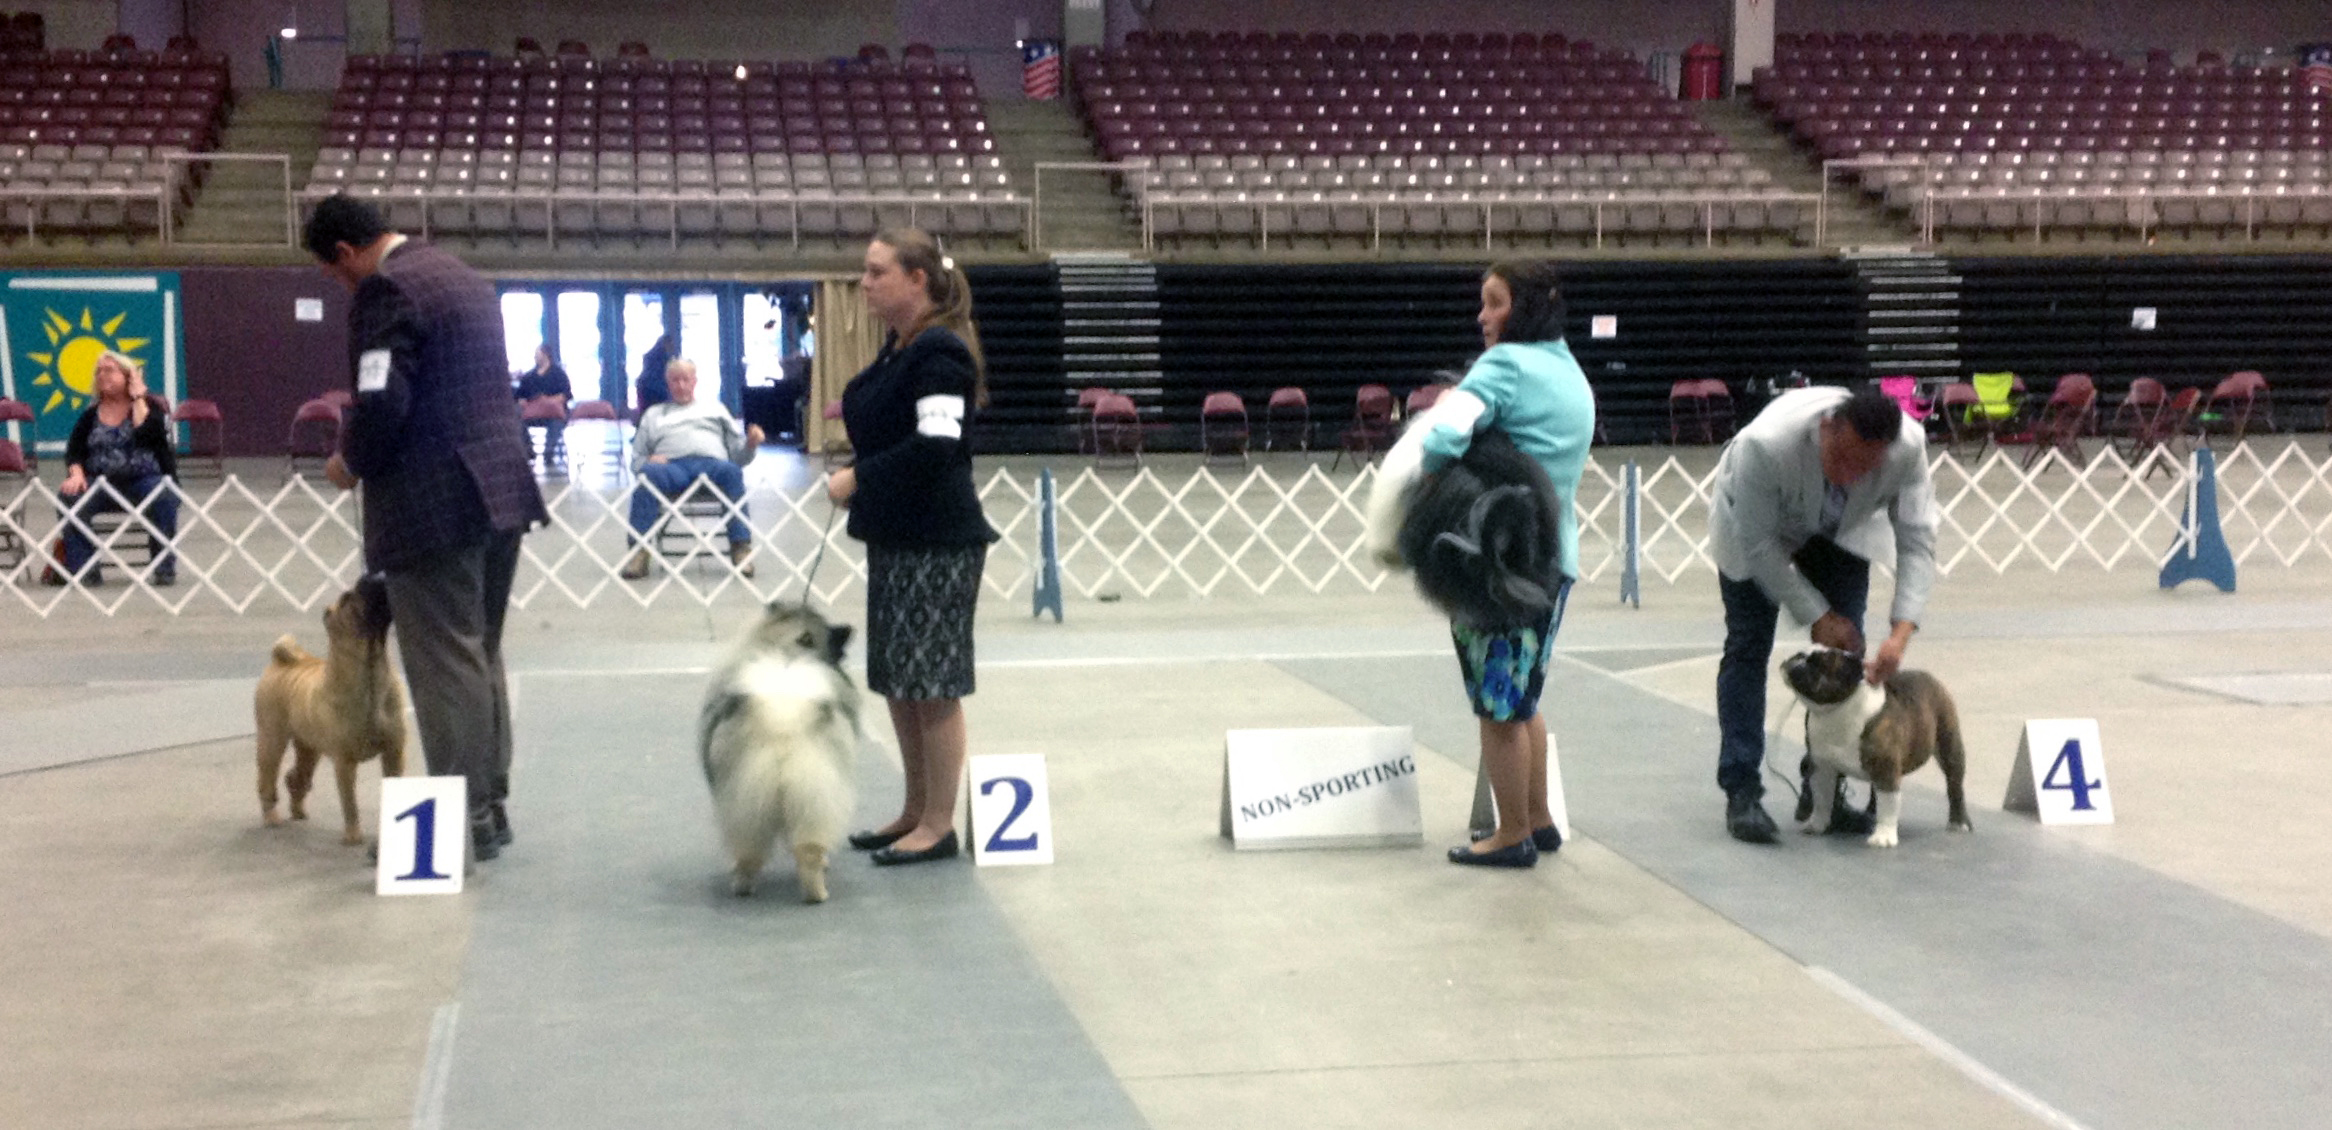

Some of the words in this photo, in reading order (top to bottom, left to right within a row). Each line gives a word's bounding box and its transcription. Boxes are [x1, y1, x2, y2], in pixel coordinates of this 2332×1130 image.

[1240, 755, 1416, 822] NON-SPORTING
[2042, 738, 2101, 811] 4
[395, 797, 451, 881] 1
[980, 775, 1038, 852] 2
